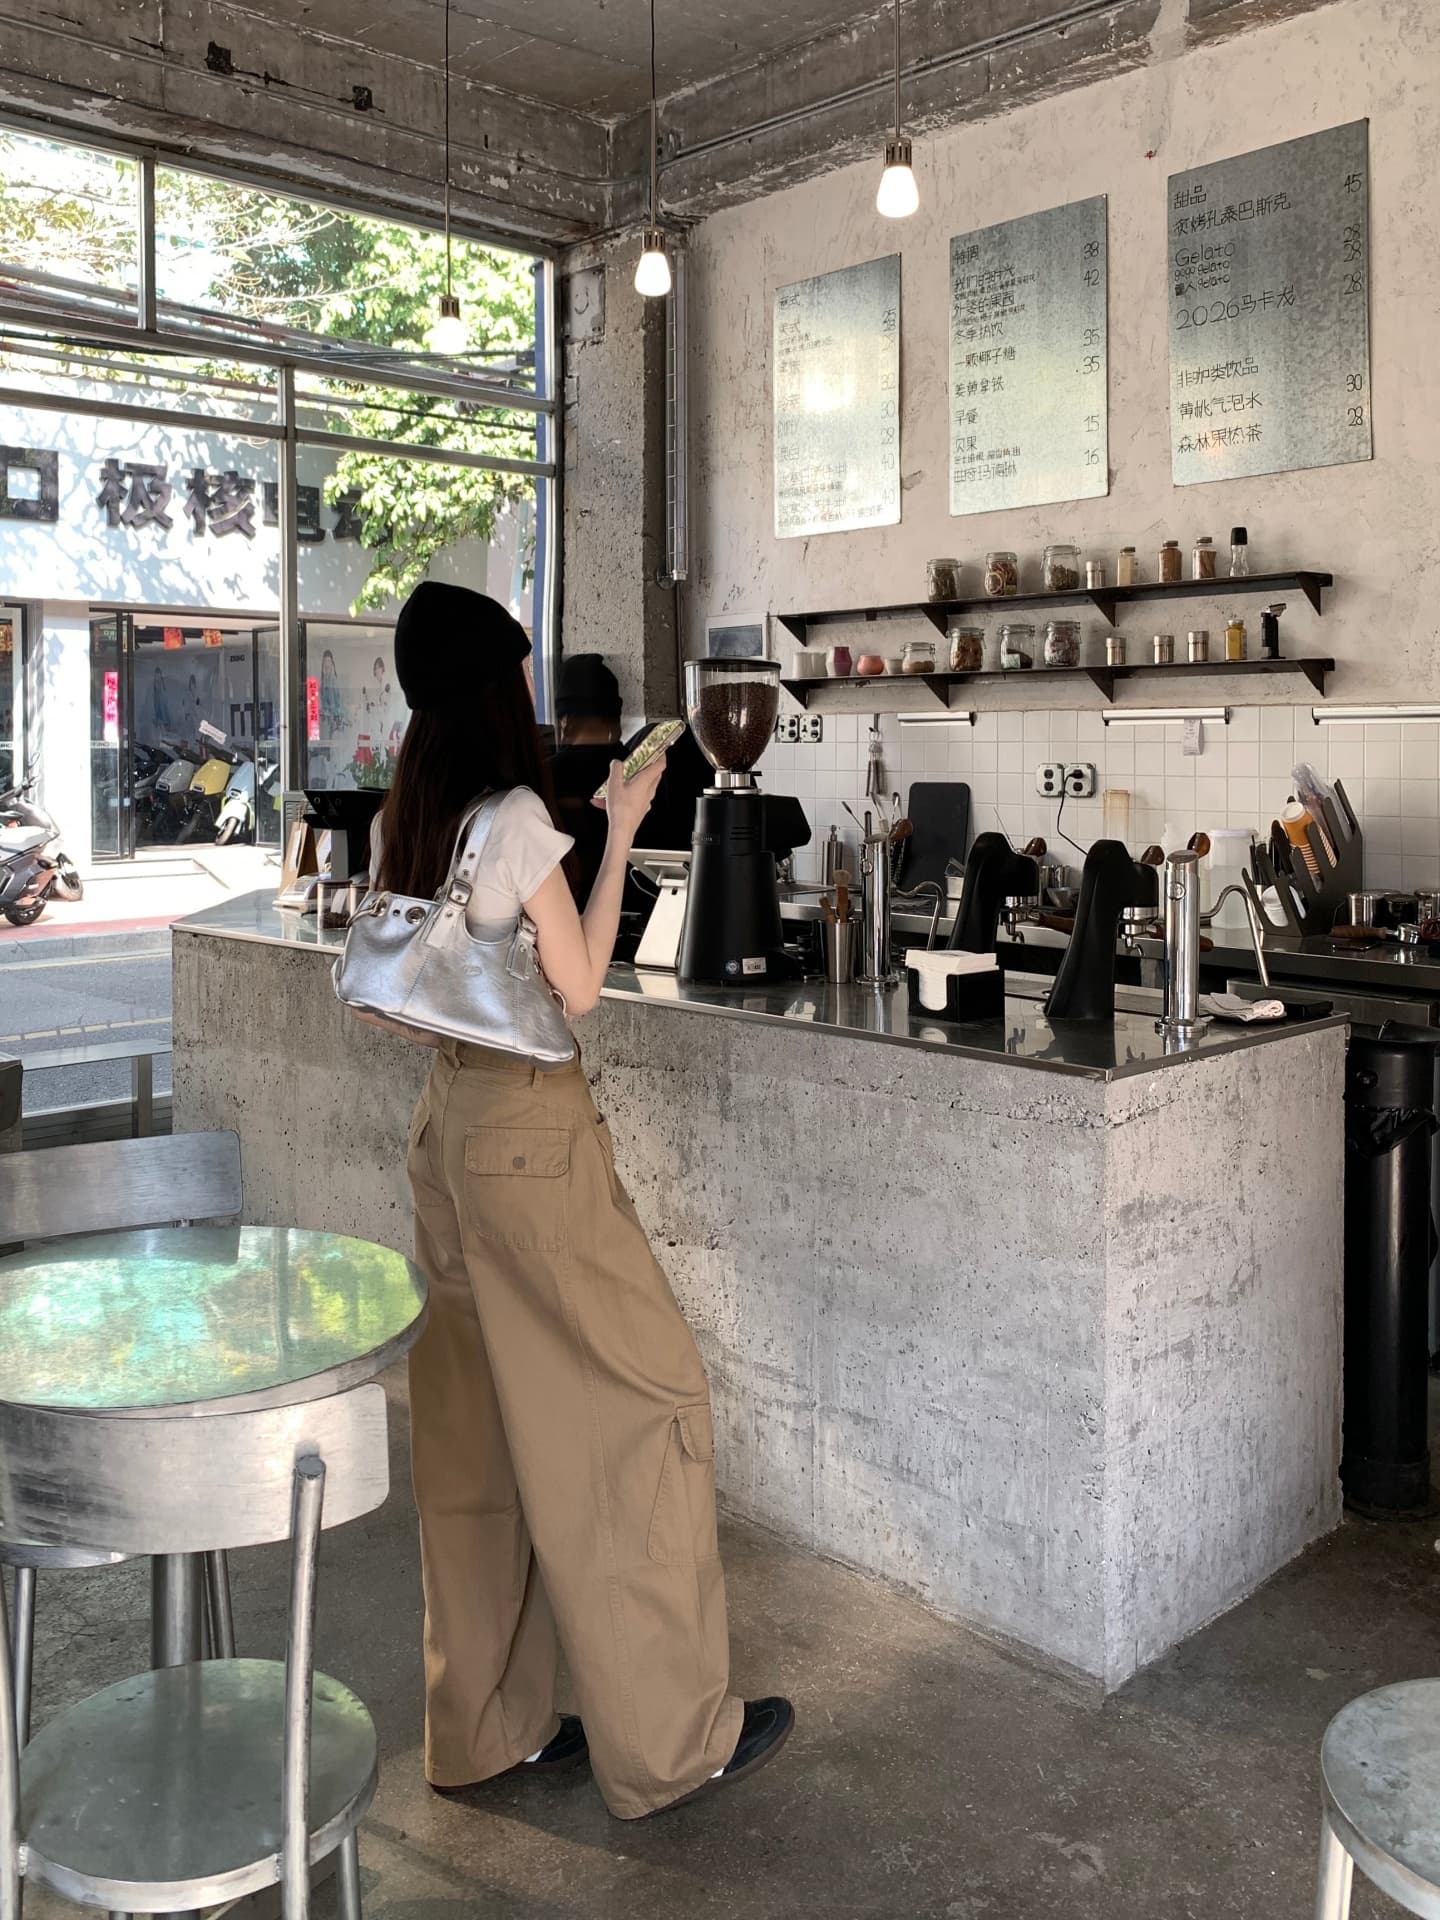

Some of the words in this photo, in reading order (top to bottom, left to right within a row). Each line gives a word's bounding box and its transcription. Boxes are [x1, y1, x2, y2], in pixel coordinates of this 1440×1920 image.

[1343, 173, 1363, 193] 45
[1173, 184, 1207, 210] 甜品
[1343, 223, 1361, 243] 28
[1083, 241, 1099, 260] 38
[1175, 241, 1236, 267] Gelato
[1343, 240, 1362, 262] 28
[1083, 269, 1100, 288] 42
[1343, 271, 1362, 295] 28
[1083, 328, 1100, 348] 35
[1082, 355, 1101, 375] 35
[1177, 357, 1259, 388] 非咖类饮品
[954, 375, 1005, 398] 姜黄拿铁
[1346, 373, 1363, 392] 30
[880, 399, 896, 420] 30
[1178, 391, 1263, 420] 黄桃气泡水
[1084, 414, 1100, 433] 15
[1347, 407, 1364, 427] 28
[1177, 424, 1263, 454] 森林果热茶
[1084, 448, 1099, 466] 16
